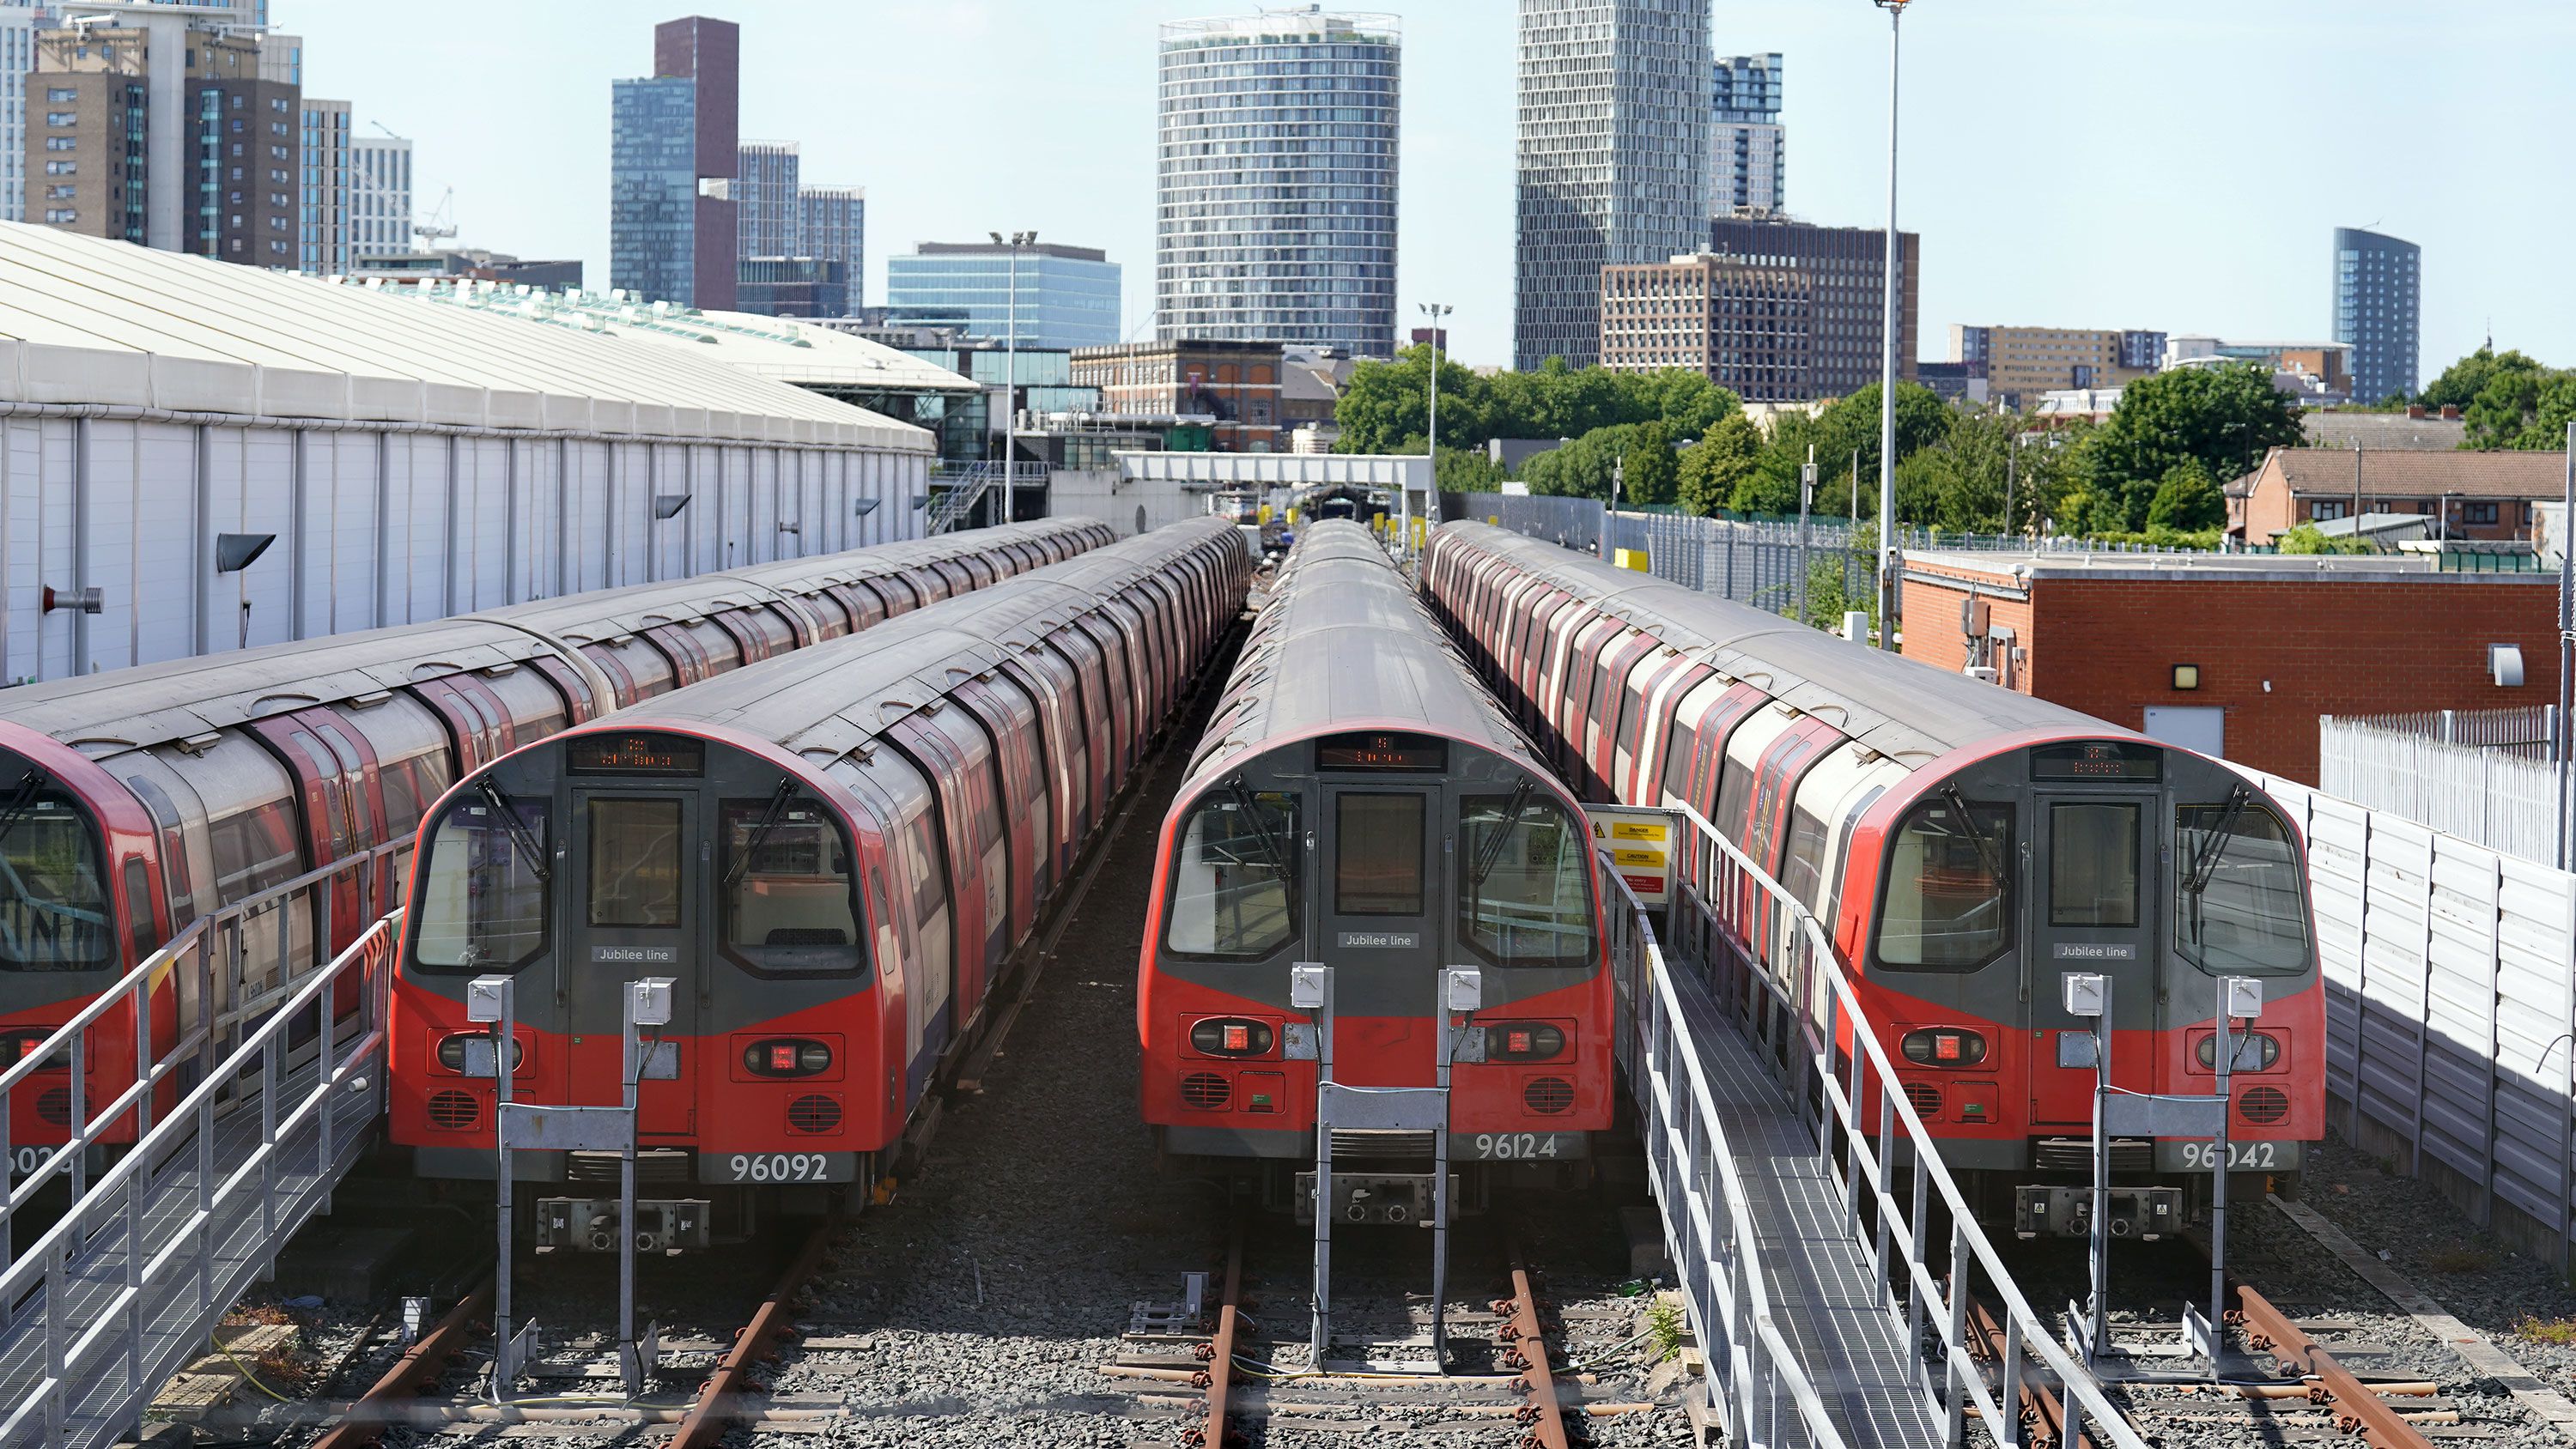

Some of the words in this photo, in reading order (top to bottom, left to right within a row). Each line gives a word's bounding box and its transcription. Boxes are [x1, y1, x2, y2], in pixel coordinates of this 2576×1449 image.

[1346, 935, 1387, 945] Jubilee
[1390, 936, 1411, 945] line
[600, 949, 642, 960] Jubilee
[647, 949, 668, 960] line
[2062, 946, 2103, 956] Jubilee
[2106, 947, 2127, 957] line
[1476, 1133, 1557, 1159] 96124
[2183, 1143, 2274, 1167] 96042
[730, 1154, 827, 1181] 96092
